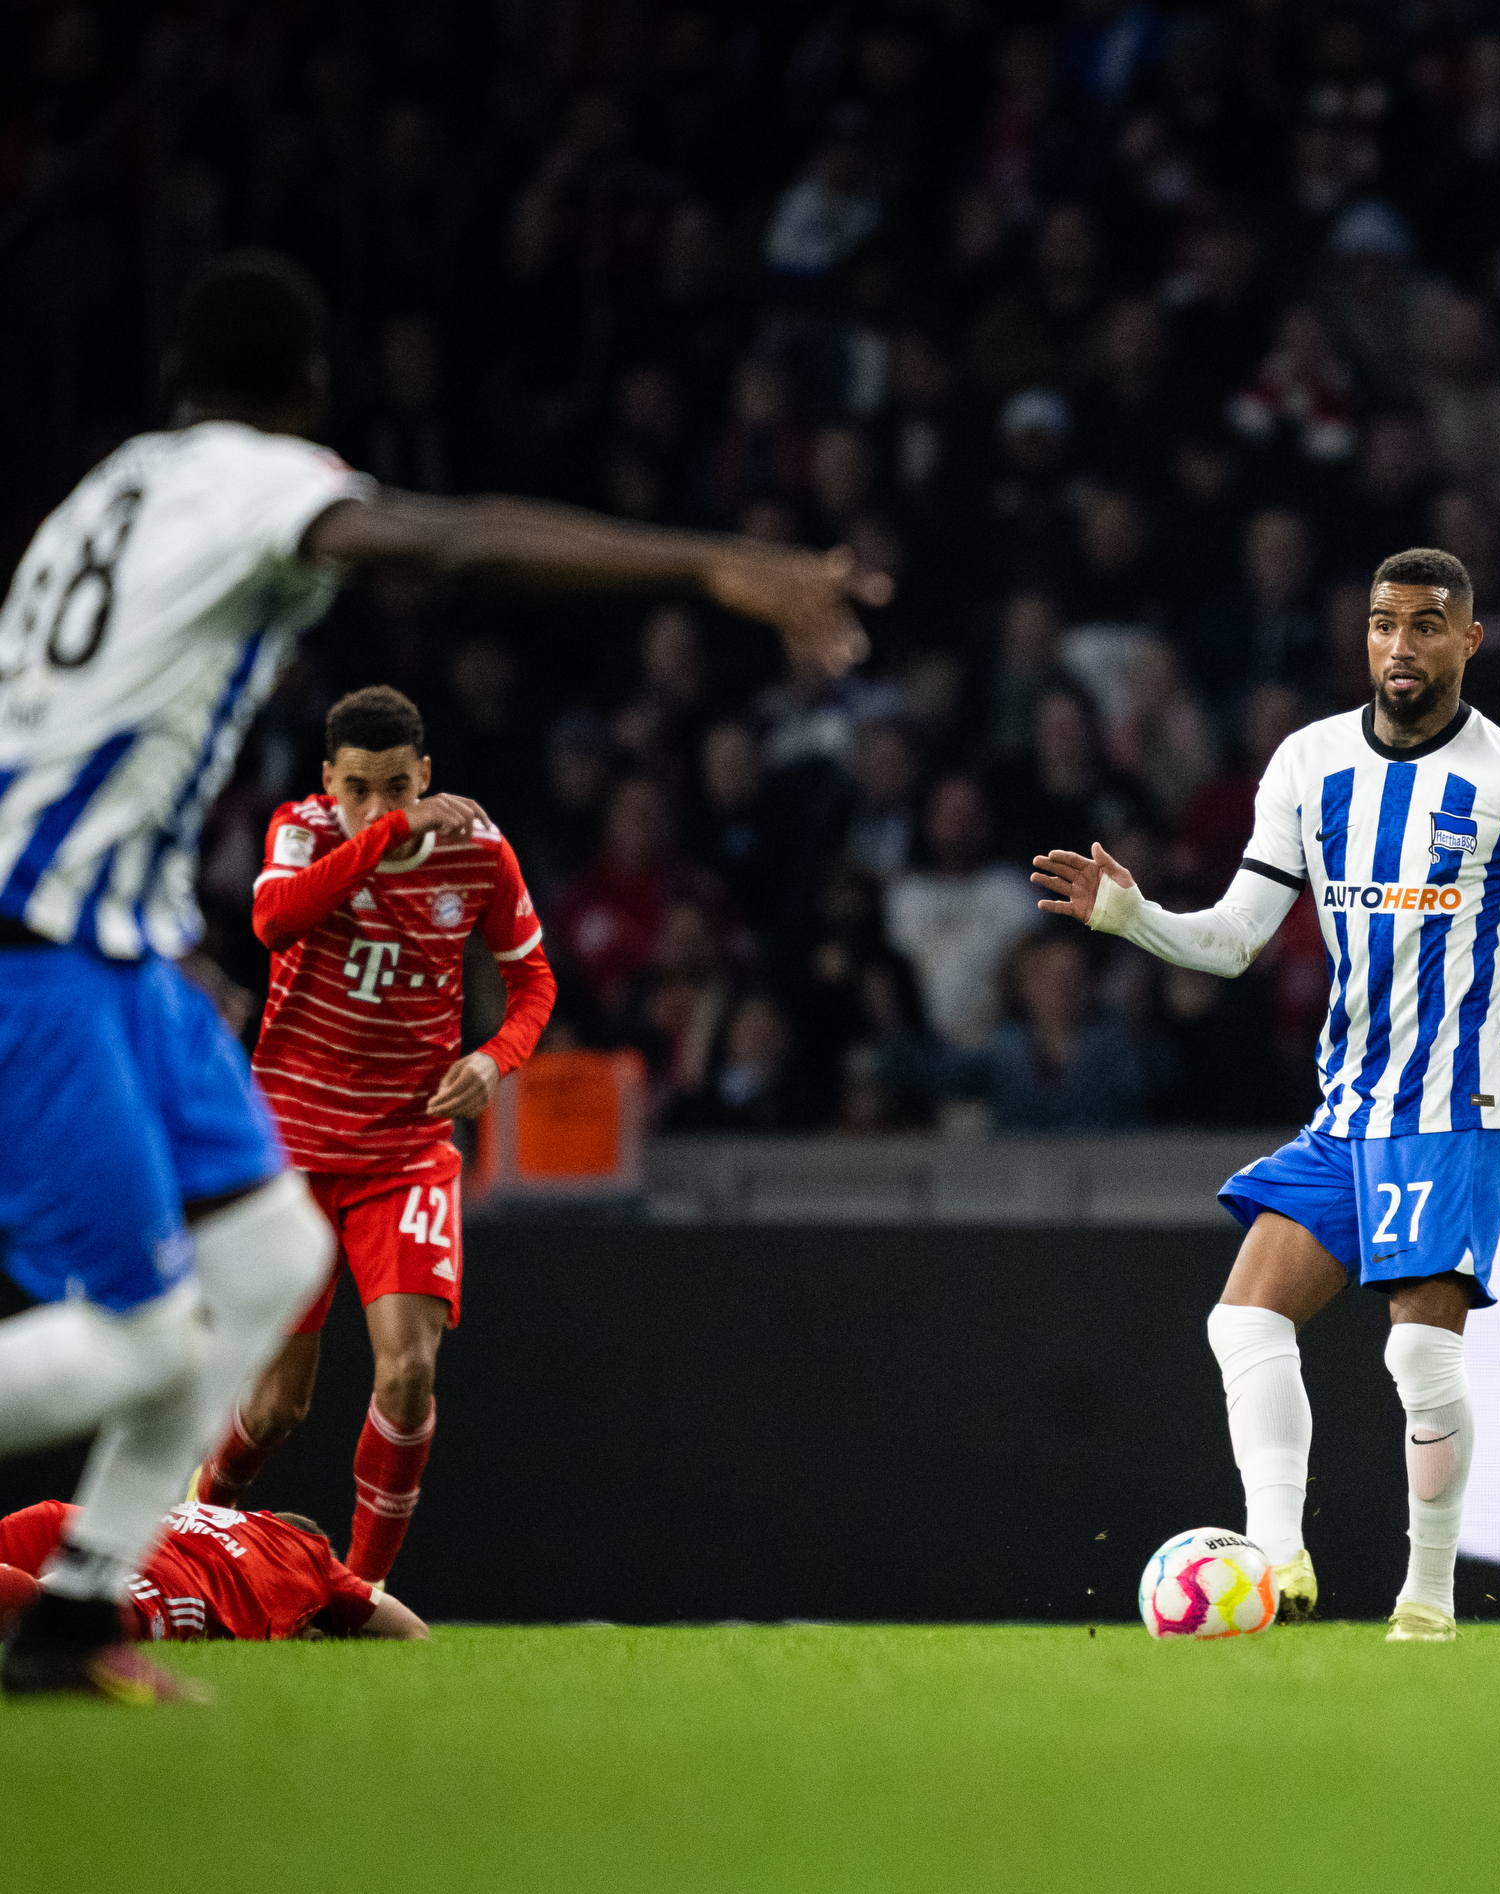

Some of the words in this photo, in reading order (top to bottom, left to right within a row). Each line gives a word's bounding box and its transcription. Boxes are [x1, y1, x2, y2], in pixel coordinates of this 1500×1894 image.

[1436, 831, 1461, 847] Hertha
[1461, 835, 1475, 850] BSC
[1323, 885, 1462, 911] AUTOHERO
[399, 1185, 451, 1248] 42
[1372, 1181, 1433, 1244] 27
